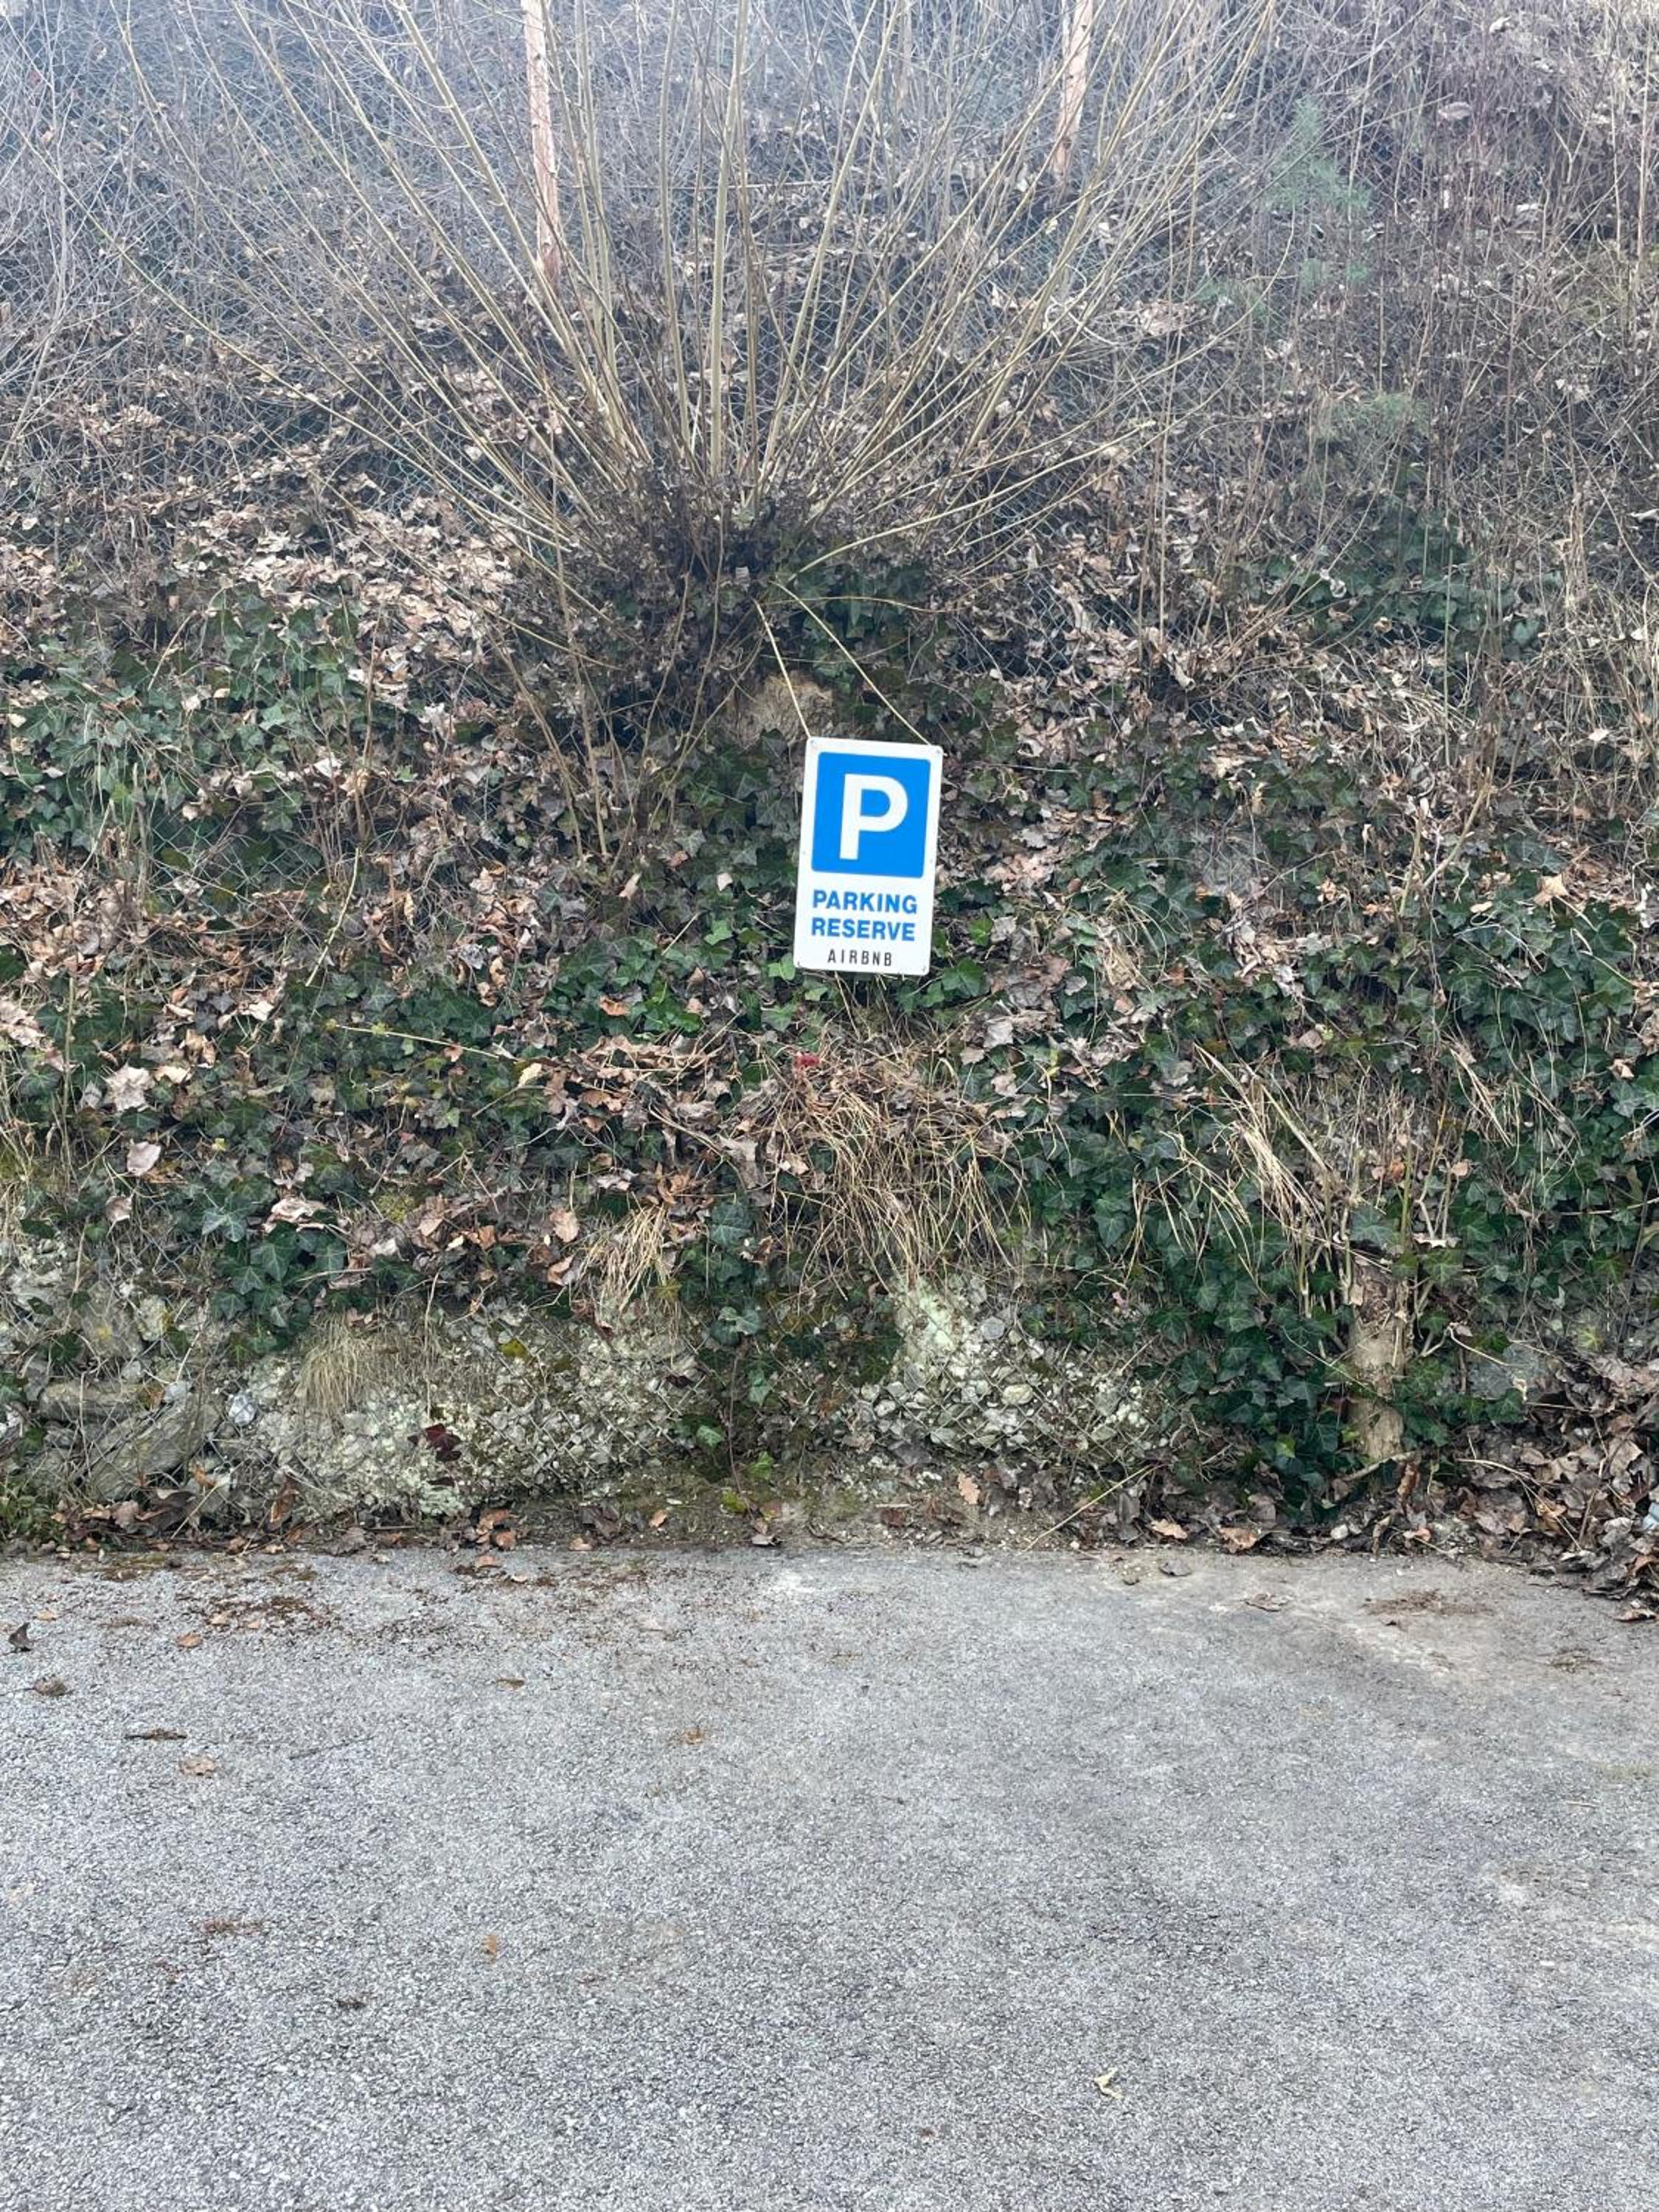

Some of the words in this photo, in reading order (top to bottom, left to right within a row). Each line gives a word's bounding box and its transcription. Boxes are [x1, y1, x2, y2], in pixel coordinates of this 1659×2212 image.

[839, 773, 908, 860] P
[813, 889, 918, 914] PARKING
[812, 917, 916, 942] RESERVE
[827, 948, 892, 967] AIRBNB
